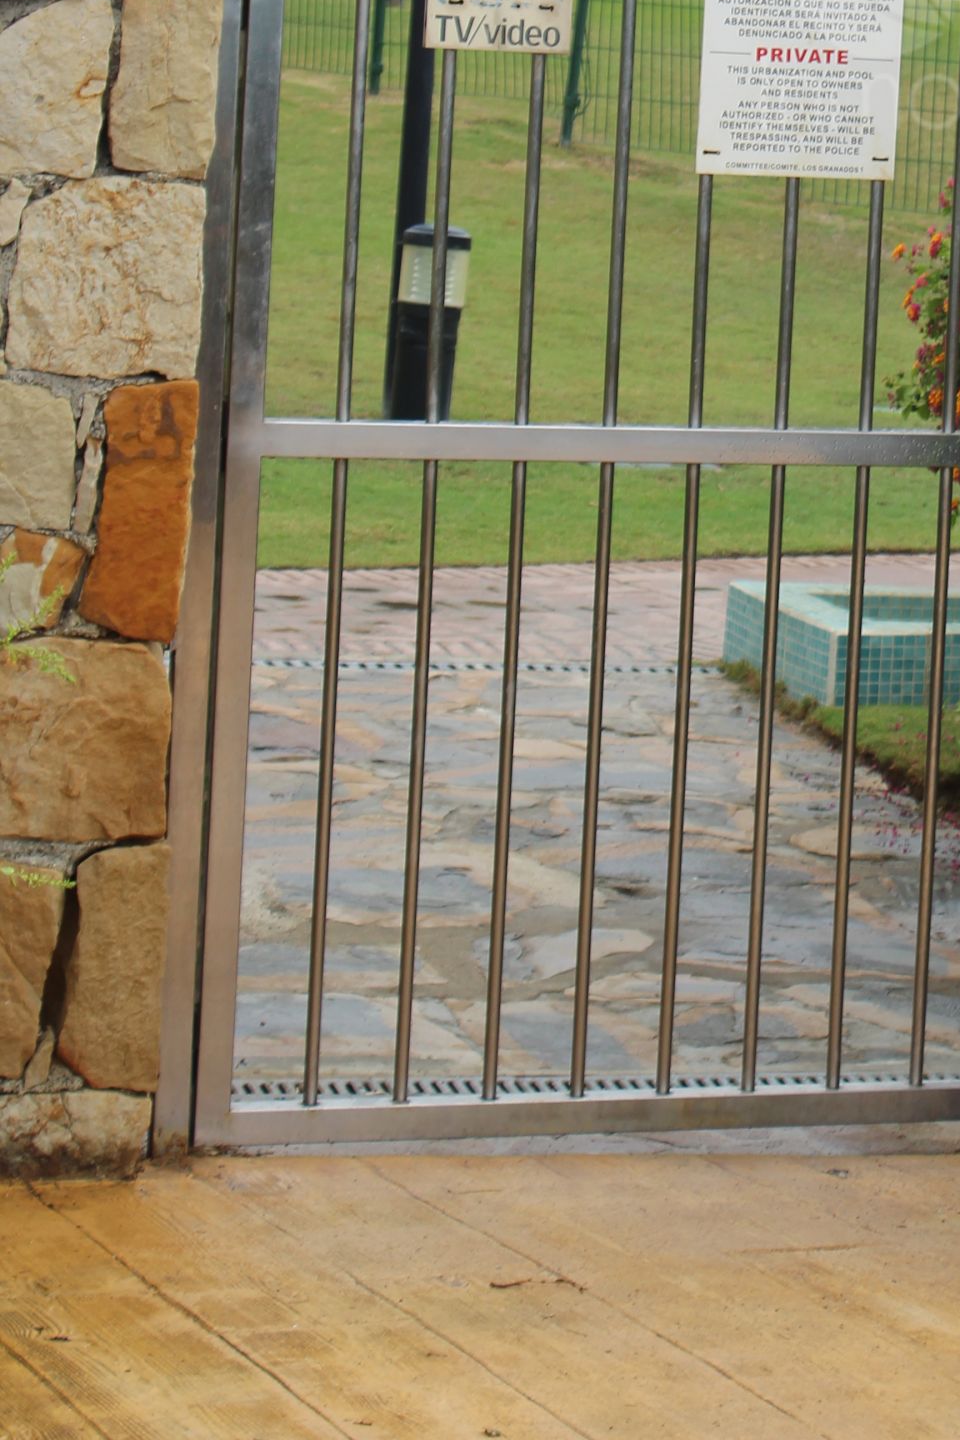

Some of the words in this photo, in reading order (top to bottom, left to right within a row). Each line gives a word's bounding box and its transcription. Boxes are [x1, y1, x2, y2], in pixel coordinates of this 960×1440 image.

[804, 0, 824, 9] QUE
[843, 2, 854, 10] SE
[858, 3, 890, 12] PUEDA
[731, 7, 791, 17] IDENTIFICAR
[823, 12, 868, 21] INVITADO
[724, 18, 785, 28] ABANDONAR
[789, 21, 800, 29] EL
[803, 21, 845, 30] RECINTO
[435, 14, 561, 47] TV/video
[739, 29, 803, 39] DENUNCIADO
[756, 47, 848, 64] PRIVATE
[727, 65, 748, 74] THIS
[752, 67, 822, 77] URBANIZATION
[825, 70, 845, 78] AND
[848, 71, 874, 80] POOL
[737, 77, 746, 85] IS
[750, 77, 774, 86] ONLY
[777, 79, 803, 88] OPEN
[807, 80, 819, 88] TO
[821, 81, 862, 90] OWNERS
[761, 89, 781, 97] AND
[784, 90, 838, 99] RESIDENTS
[738, 101, 758, 109] ANY
[761, 102, 799, 110] PERSON
[803, 103, 825, 111] WHO
[828, 104, 837, 112] IS
[840, 105, 859, 113] NOT
[722, 111, 784, 121] AUTHORIZED
[793, 114, 806, 122] OR
[809, 115, 831, 123] WHO
[834, 115, 874, 124] CANNOT
[719, 121, 763, 131] IDENTIFY
[766, 123, 829, 133] THEMSELVES
[837, 126, 860, 134] WILL
[863, 127, 875, 135] BE
[803, 136, 823, 144] AND
[851, 137, 863, 145] BE
[733, 143, 785, 152] REPORTED
[789, 145, 800, 153] TO
[804, 146, 821, 154] THE
[825, 146, 860, 155] POLICE
